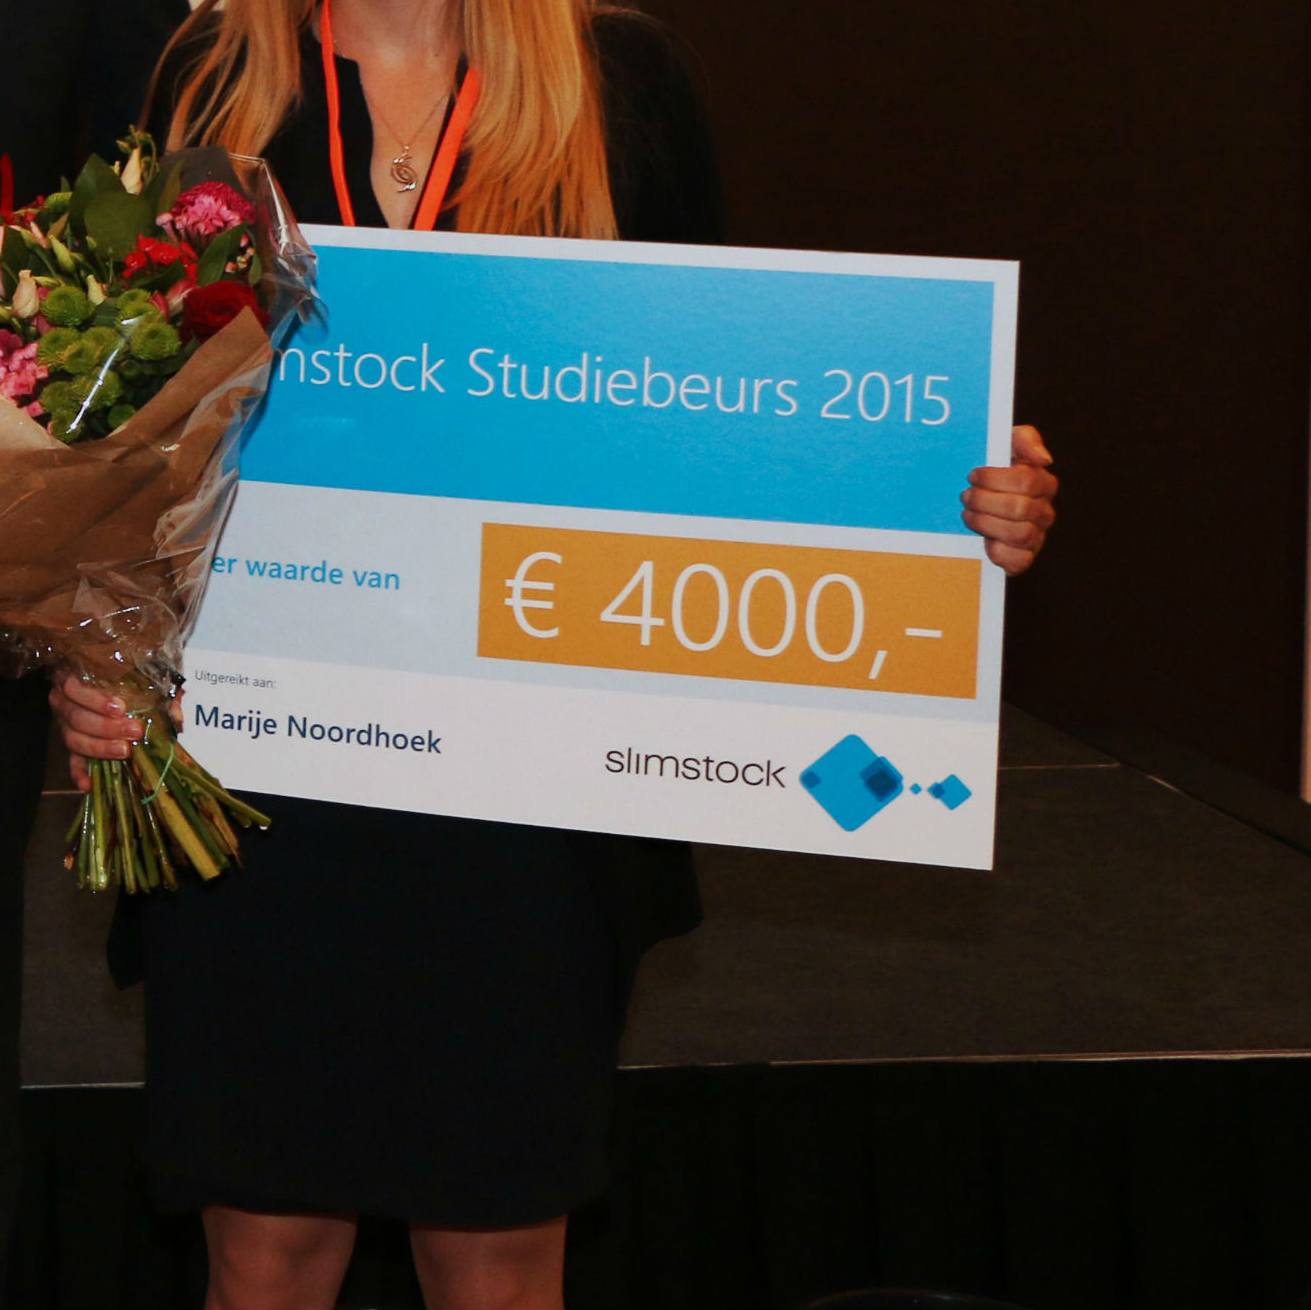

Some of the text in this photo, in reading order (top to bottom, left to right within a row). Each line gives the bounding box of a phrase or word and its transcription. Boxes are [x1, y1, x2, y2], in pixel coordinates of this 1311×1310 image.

[467, 347, 799, 417] Studiebeurs
[820, 368, 951, 426] 2015
[211, 553, 400, 590] er waarde van
[504, 551, 943, 680] € 4000,-
[194, 670, 249, 686] Uitgereikt
[195, 704, 442, 754] Marije Noordhoek
[605, 747, 786, 789] slimstock
